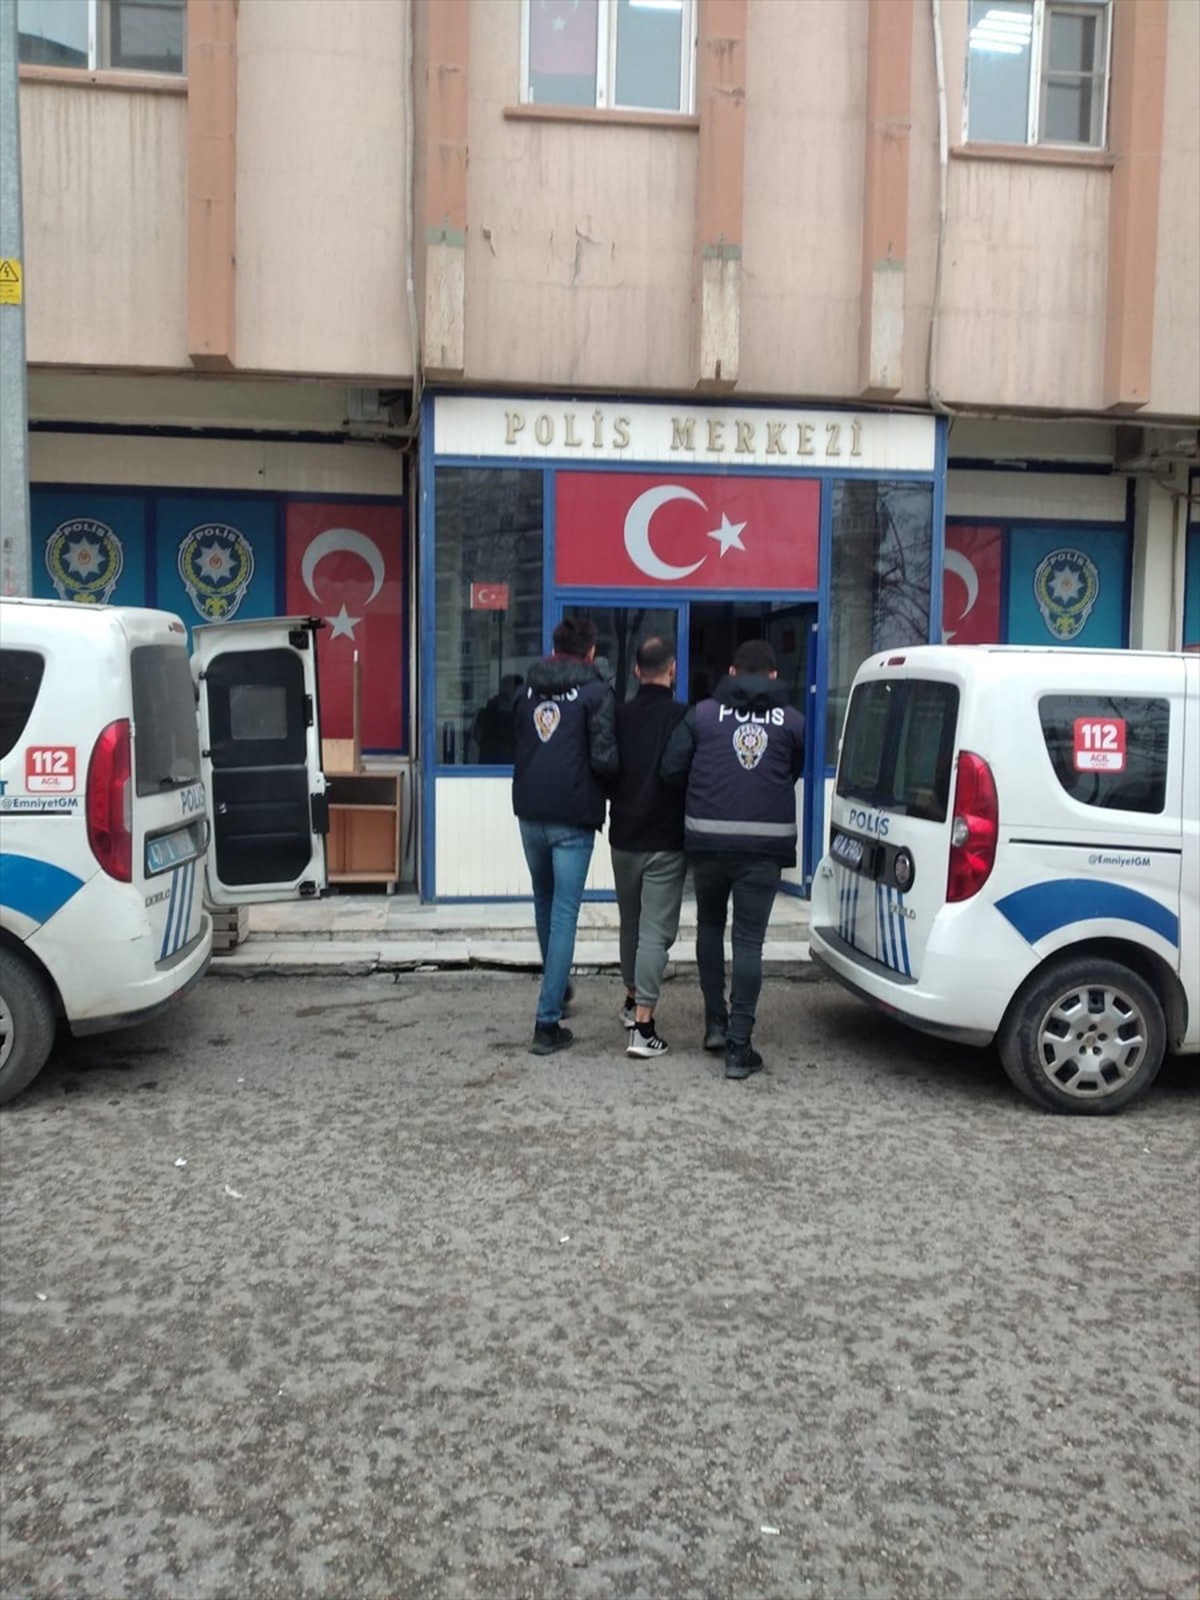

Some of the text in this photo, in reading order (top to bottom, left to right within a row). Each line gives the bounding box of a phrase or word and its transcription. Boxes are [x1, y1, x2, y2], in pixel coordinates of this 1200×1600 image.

[504, 409, 865, 458] POLİS MERKEZİ
[1081, 723, 1118, 750] 112
[32, 750, 69, 774] 112
[1, 798, 79, 811] @EmniyetGM
[1088, 854, 1151, 868] @EmniyetGM
